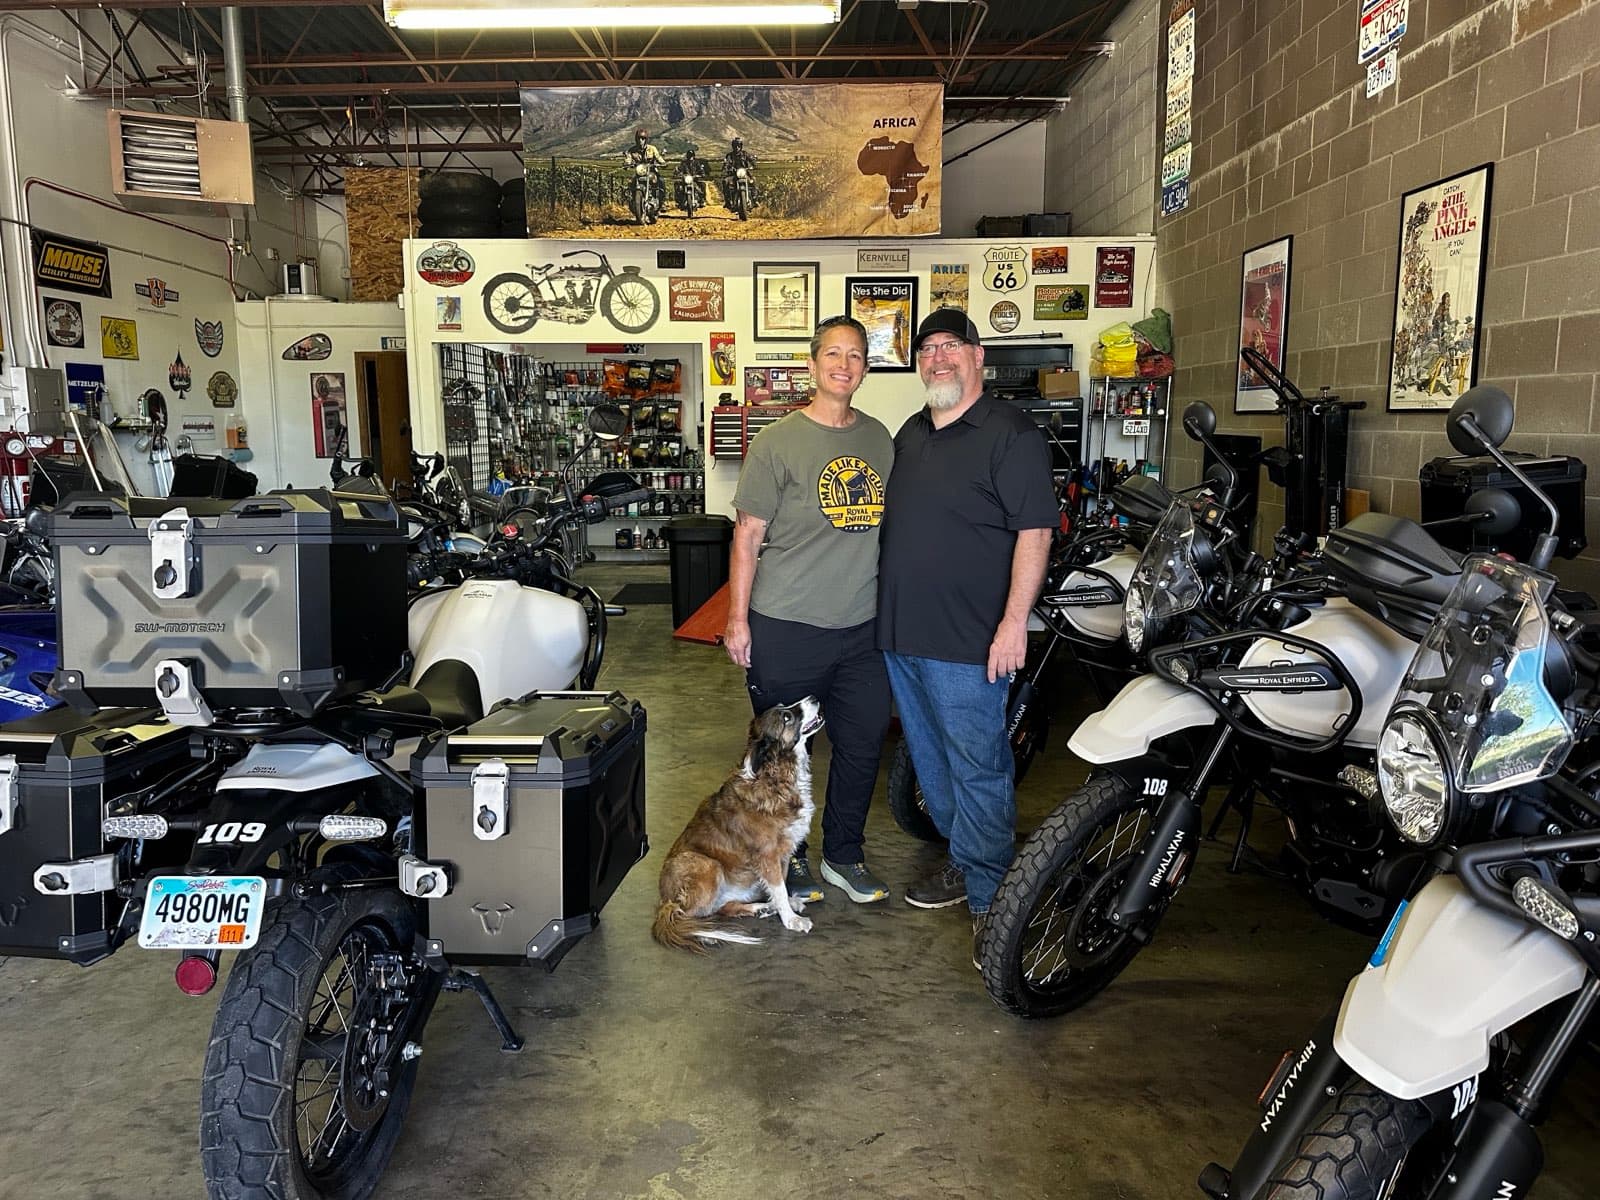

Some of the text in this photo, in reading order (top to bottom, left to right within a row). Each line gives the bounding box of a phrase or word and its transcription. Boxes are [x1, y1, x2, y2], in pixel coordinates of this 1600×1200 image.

[873, 117, 917, 128] AFRICA
[1447, 190, 1466, 206] THE
[1437, 202, 1468, 225] PINK
[1432, 216, 1477, 241] ANGELS
[44, 247, 103, 276] MOOSE
[860, 254, 907, 262] KERNVILLE
[993, 251, 1020, 260] ROUTE
[42, 266, 69, 278] UTILITY
[933, 265, 967, 274] ARIEL
[69, 272, 100, 284] DIVISION
[993, 272, 1017, 289] 66
[856, 287, 907, 296] Yes She Did
[67, 380, 98, 388] METZELER
[821, 466, 837, 501] MADE
[836, 458, 860, 470] LIKE
[869, 473, 884, 498] GUN
[134, 622, 226, 633] SW-MOTECH
[1283, 676, 1311, 684] ENFIELD
[1143, 778, 1168, 796] 108
[197, 822, 267, 844] 109
[1149, 830, 1185, 888] HIMALAYAN
[155, 894, 250, 923] 4980MG
[1261, 1040, 1316, 1132] HIMALAYAN
